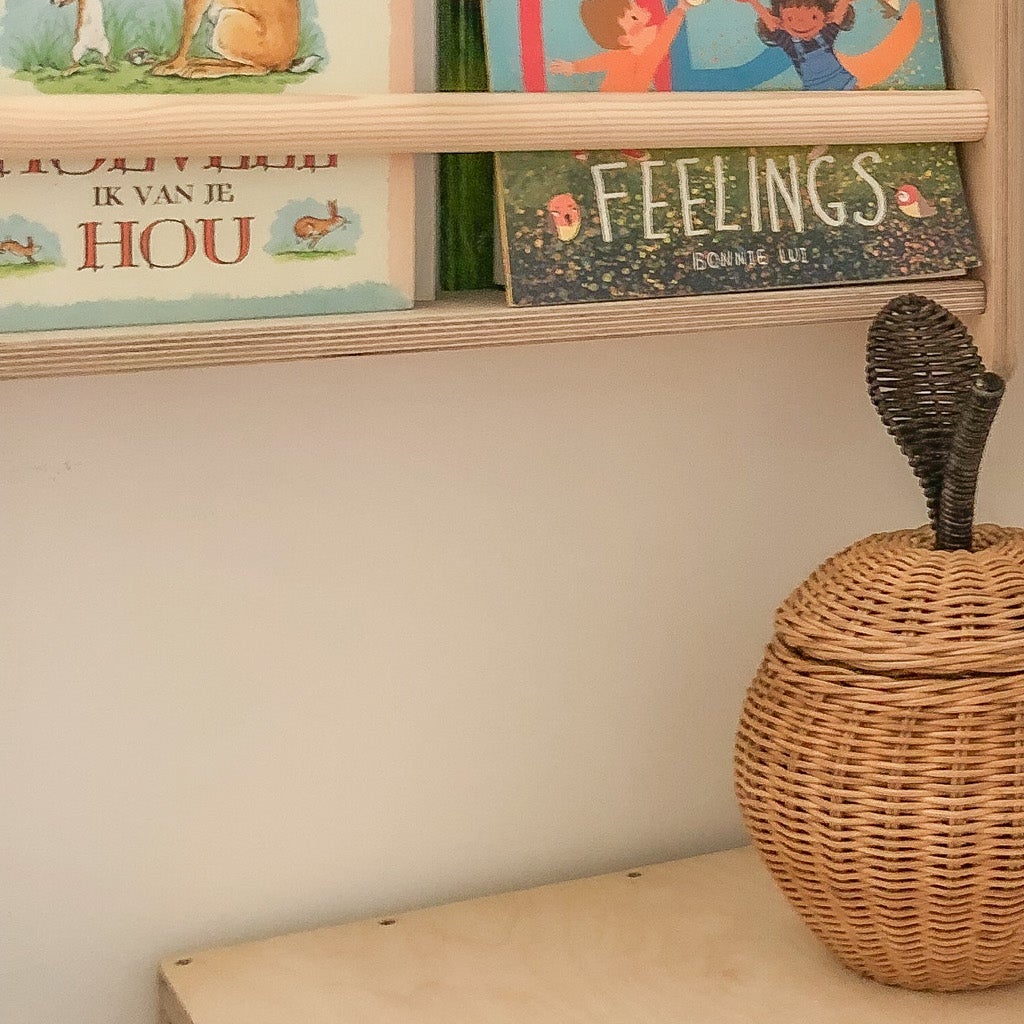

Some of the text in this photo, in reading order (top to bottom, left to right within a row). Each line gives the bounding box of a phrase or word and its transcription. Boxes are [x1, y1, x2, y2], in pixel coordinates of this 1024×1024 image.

[92, 182, 235, 207] IK VAN JE
[590, 150, 888, 243] FEELINGS
[77, 216, 254, 271] HOU
[692, 247, 809, 271] BONNIE LUI
